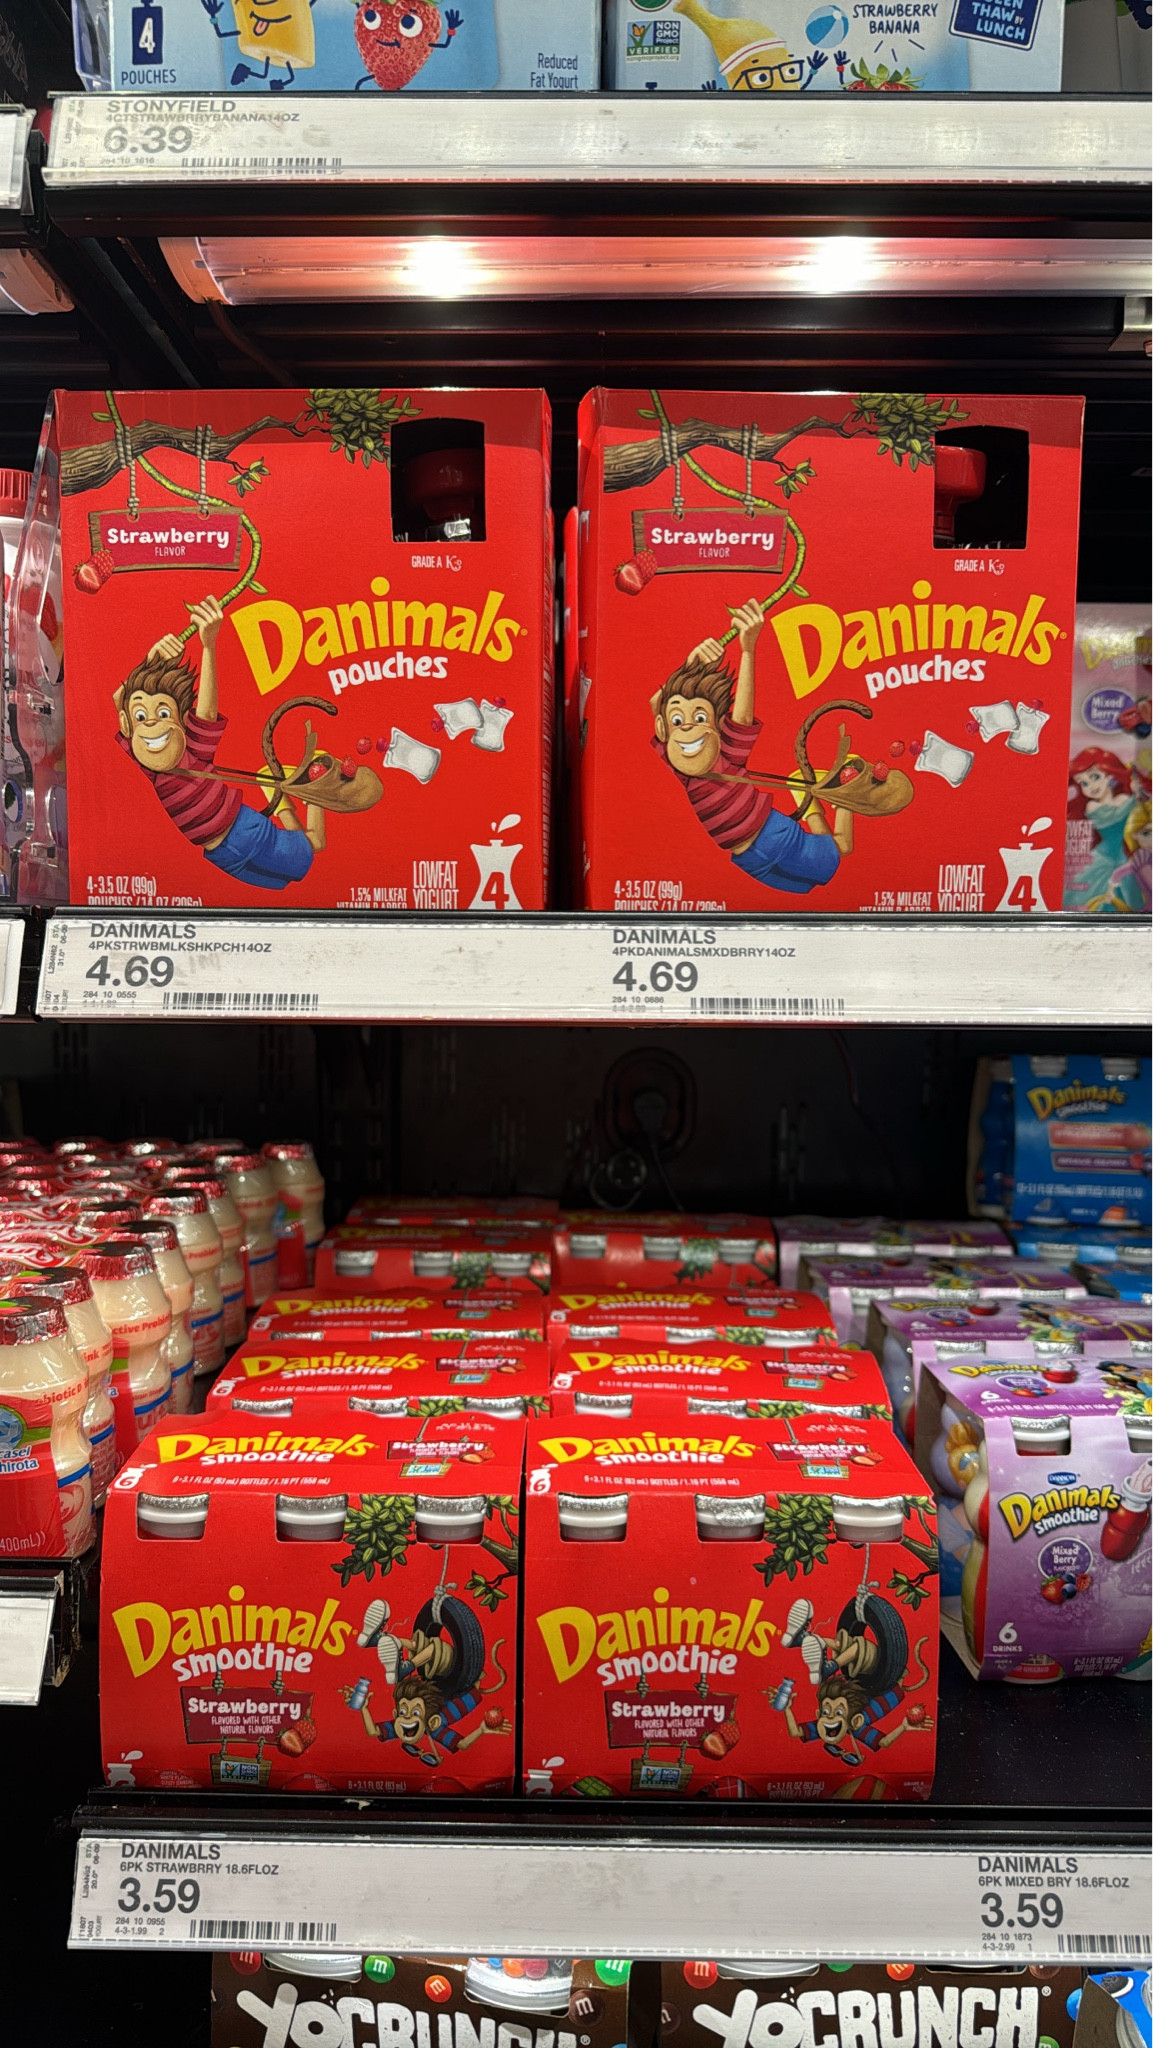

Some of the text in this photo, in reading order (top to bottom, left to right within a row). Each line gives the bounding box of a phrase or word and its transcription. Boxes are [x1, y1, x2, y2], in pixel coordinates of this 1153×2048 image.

[853, 4, 938, 18] STRAWBERRY
[972, 3, 1015, 22] THAW
[656, 22, 679, 30] NON
[656, 30, 679, 38] GMO
[870, 20, 920, 34] BANANA
[976, 19, 1026, 40] LUNCH
[139, 18, 156, 54] 4
[629, 46, 678, 55] VERIFIED
[538, 53, 578, 70] Reduced
[122, 69, 176, 85] POUCHES
[530, 72, 578, 89] Fat Yogurt
[107, 100, 236, 112] STONYFIELD
[104, 126, 192, 154] 6.39
[107, 526, 230, 550] Strawberry
[652, 528, 774, 550] Strawberry
[154, 545, 186, 558] FLAVOR
[699, 548, 730, 558] FLAVOR
[412, 556, 435, 568] GRADE
[436, 556, 442, 568] A
[954, 560, 978, 572] GRADE
[979, 560, 984, 572] A
[230, 576, 522, 696] Danimals
[770, 580, 1060, 700] Danimals
[328, 652, 448, 696] pouches
[864, 654, 986, 698] pouches
[1092, 696, 1125, 708] Mixed
[413, 861, 458, 888] LOWFAT
[938, 865, 985, 892] LOWFAT
[117, 876, 157, 896] OZ (99g)
[482, 872, 509, 910] 4
[643, 880, 682, 901] OZ (99g)
[1008, 876, 1037, 912] 4
[350, 888, 407, 902] 1.5% MILKFAT
[412, 889, 459, 909] YOGURT
[874, 892, 932, 906] 1.5% MILKFAT
[938, 893, 985, 912] YOGURT
[90, 924, 196, 939] DANIMALS
[613, 930, 716, 945] DANIMALS
[89, 941, 272, 953] 4PKSTRWBMLKSHKPCH14OZ
[612, 947, 796, 957] 4PKDANIMALSMXDBRRY14OZ
[86, 955, 174, 987] 4.69
[612, 961, 698, 992] 4.69
[1027, 1079, 1126, 1122] Danimals
[274, 1296, 432, 1316] Danimals
[559, 1292, 714, 1309] Danimals
[310, 1305, 406, 1316] smoothie
[241, 1352, 425, 1377] Danimals
[569, 1350, 750, 1372] Danimals
[280, 1365, 393, 1379] smoothie
[612, 1364, 722, 1375] smoothie
[980, 1391, 999, 1399] 6
[157, 1431, 376, 1464] Danimals
[392, 1442, 484, 1451] Strawberry
[539, 1431, 754, 1463] Danimals
[773, 1443, 866, 1452] Strawberry
[202, 1450, 334, 1466] smoothie
[594, 1450, 725, 1466] smoothie
[119, 1476, 135, 1486] 6
[239, 1477, 268, 1485] BOTTLES
[532, 1479, 545, 1491] 6
[1000, 1486, 1121, 1541] Danimals
[1035, 1507, 1098, 1535] smoothie
[1052, 1543, 1079, 1555] Mixed
[1053, 1555, 1077, 1567] Berry
[112, 1585, 354, 1678] Danimals
[537, 1587, 777, 1684] Danimals
[998, 1622, 1017, 1644] 6
[172, 1643, 313, 1683] smoothie
[596, 1645, 738, 1686] smoothie
[188, 1698, 300, 1720] Strawberry
[612, 1701, 725, 1722] Strawberry
[212, 1715, 281, 1725] FLAVORED WITH OTHER
[635, 1720, 664, 1728] FLAVORED
[685, 1718, 704, 1727] OTHER
[220, 1725, 274, 1734] NATURAL FLAVORS
[643, 1729, 697, 1738] NATURAL FLAVORS
[368, 1781, 374, 1789] FL
[376, 1781, 384, 1789] OZ
[786, 1781, 824, 1790] FL OZ (93 mL)
[122, 1843, 221, 1860] DANIMALS
[120, 1862, 279, 1875] 6PK STRAWBRRY 18.6FLOZ
[978, 1856, 1078, 1873] DANIMALS
[979, 1876, 1130, 1888] 6PK MIXED BRY 18.6FLOZ
[118, 1877, 200, 1914] 3.59
[980, 1892, 1063, 1928] 3.59
[115, 1927, 147, 1935] 4-3-1.99
[1014, 1933, 1032, 1941] 1873
[982, 1942, 1015, 1950] 4-3-2.99
